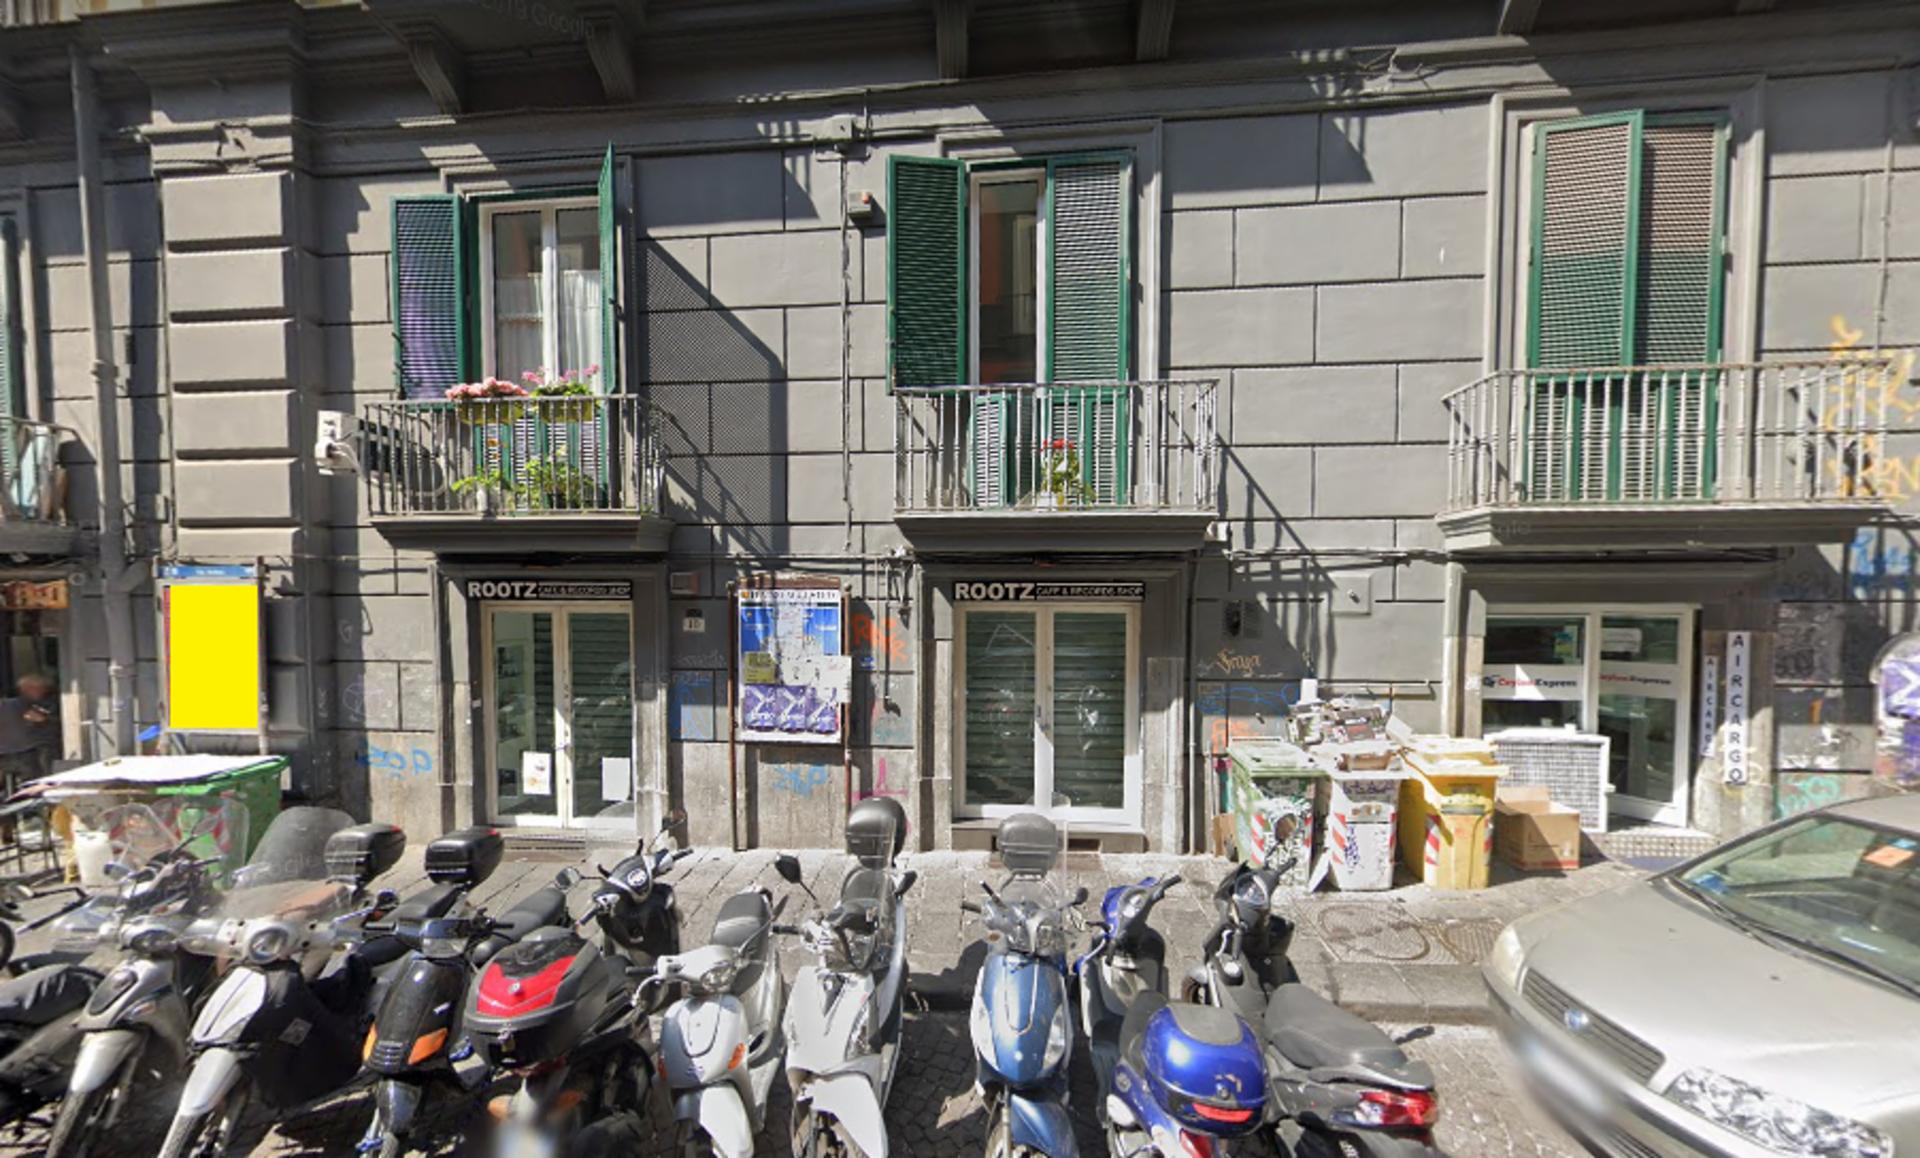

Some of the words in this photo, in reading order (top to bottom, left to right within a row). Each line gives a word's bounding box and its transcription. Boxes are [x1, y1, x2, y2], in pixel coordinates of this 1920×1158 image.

[467, 581, 538, 598] ROOTZ
[954, 582, 1036, 600] ROOTZ
[1729, 633, 1745, 784] AIRCARGO
